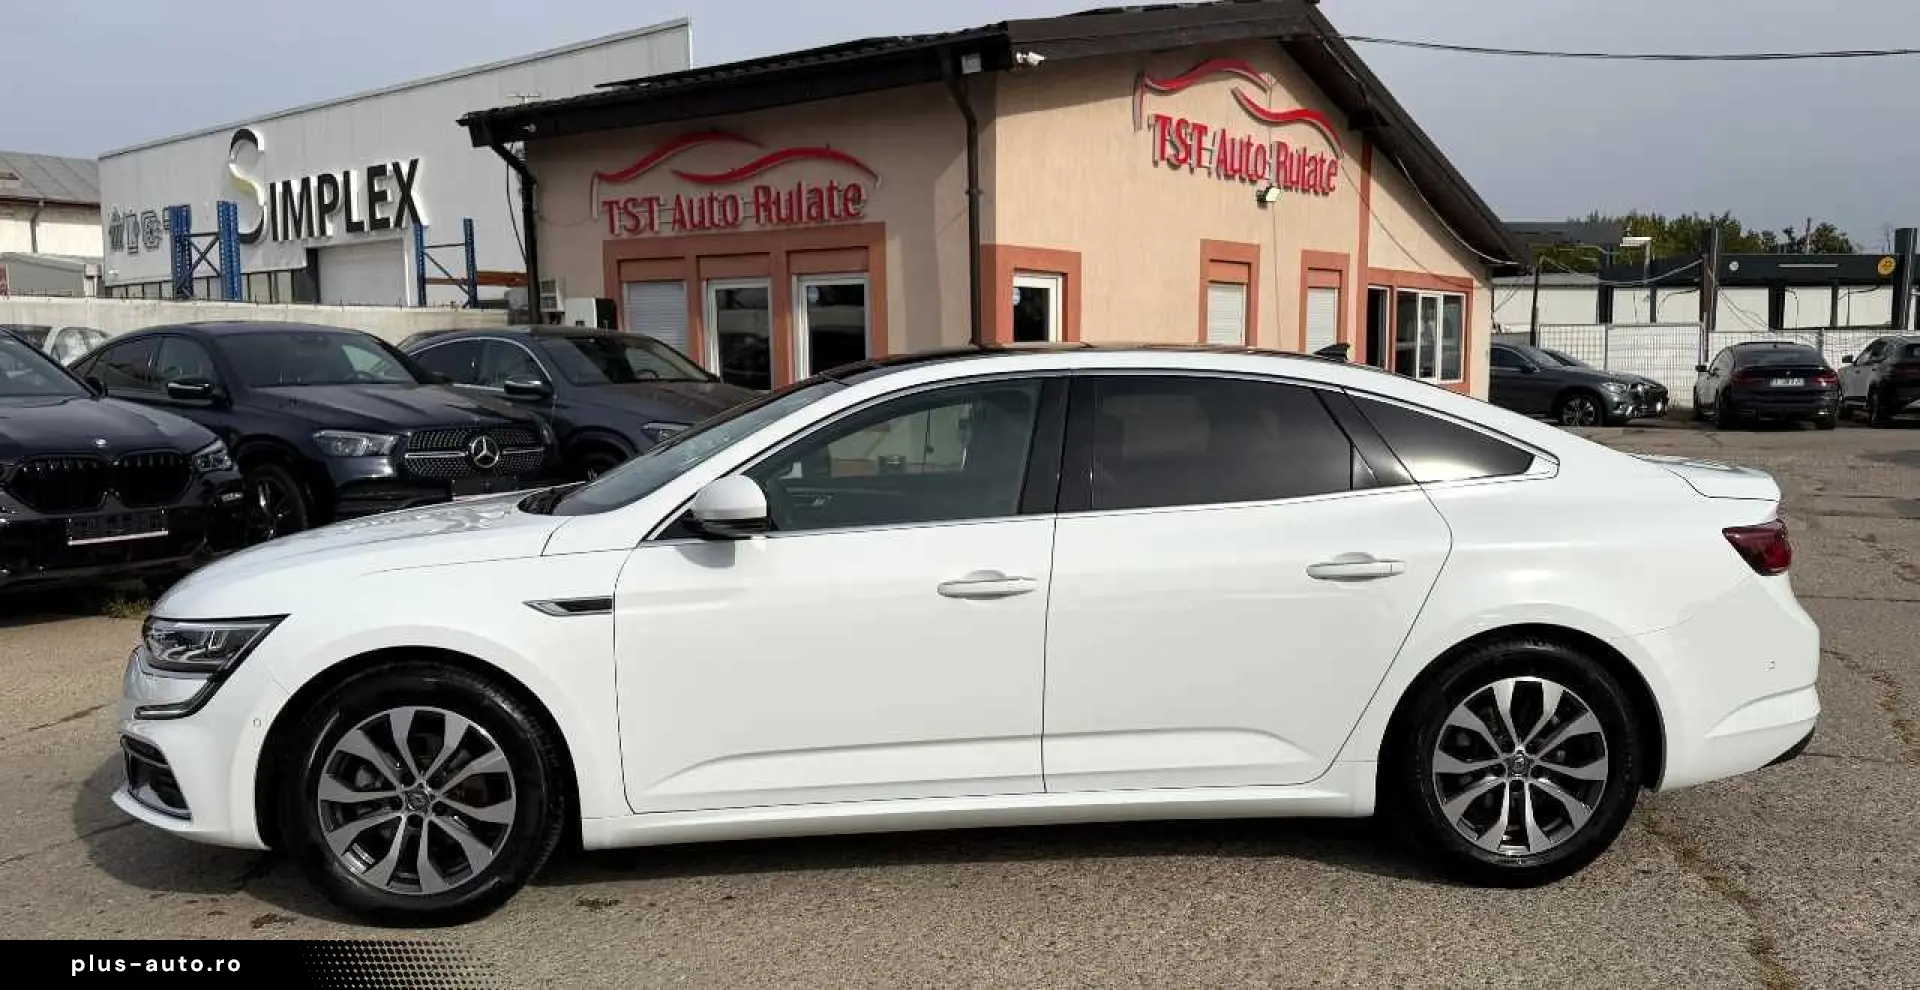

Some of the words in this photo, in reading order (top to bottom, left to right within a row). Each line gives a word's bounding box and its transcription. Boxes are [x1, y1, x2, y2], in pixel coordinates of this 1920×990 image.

[228, 128, 424, 244] SIMPLEX
[1153, 115, 1208, 169] TST
[1216, 128, 1267, 181] Auto
[1275, 140, 1338, 194] Rulate
[601, 196, 660, 235] TST
[672, 193, 740, 231] Auto
[753, 180, 866, 224] Rulate
